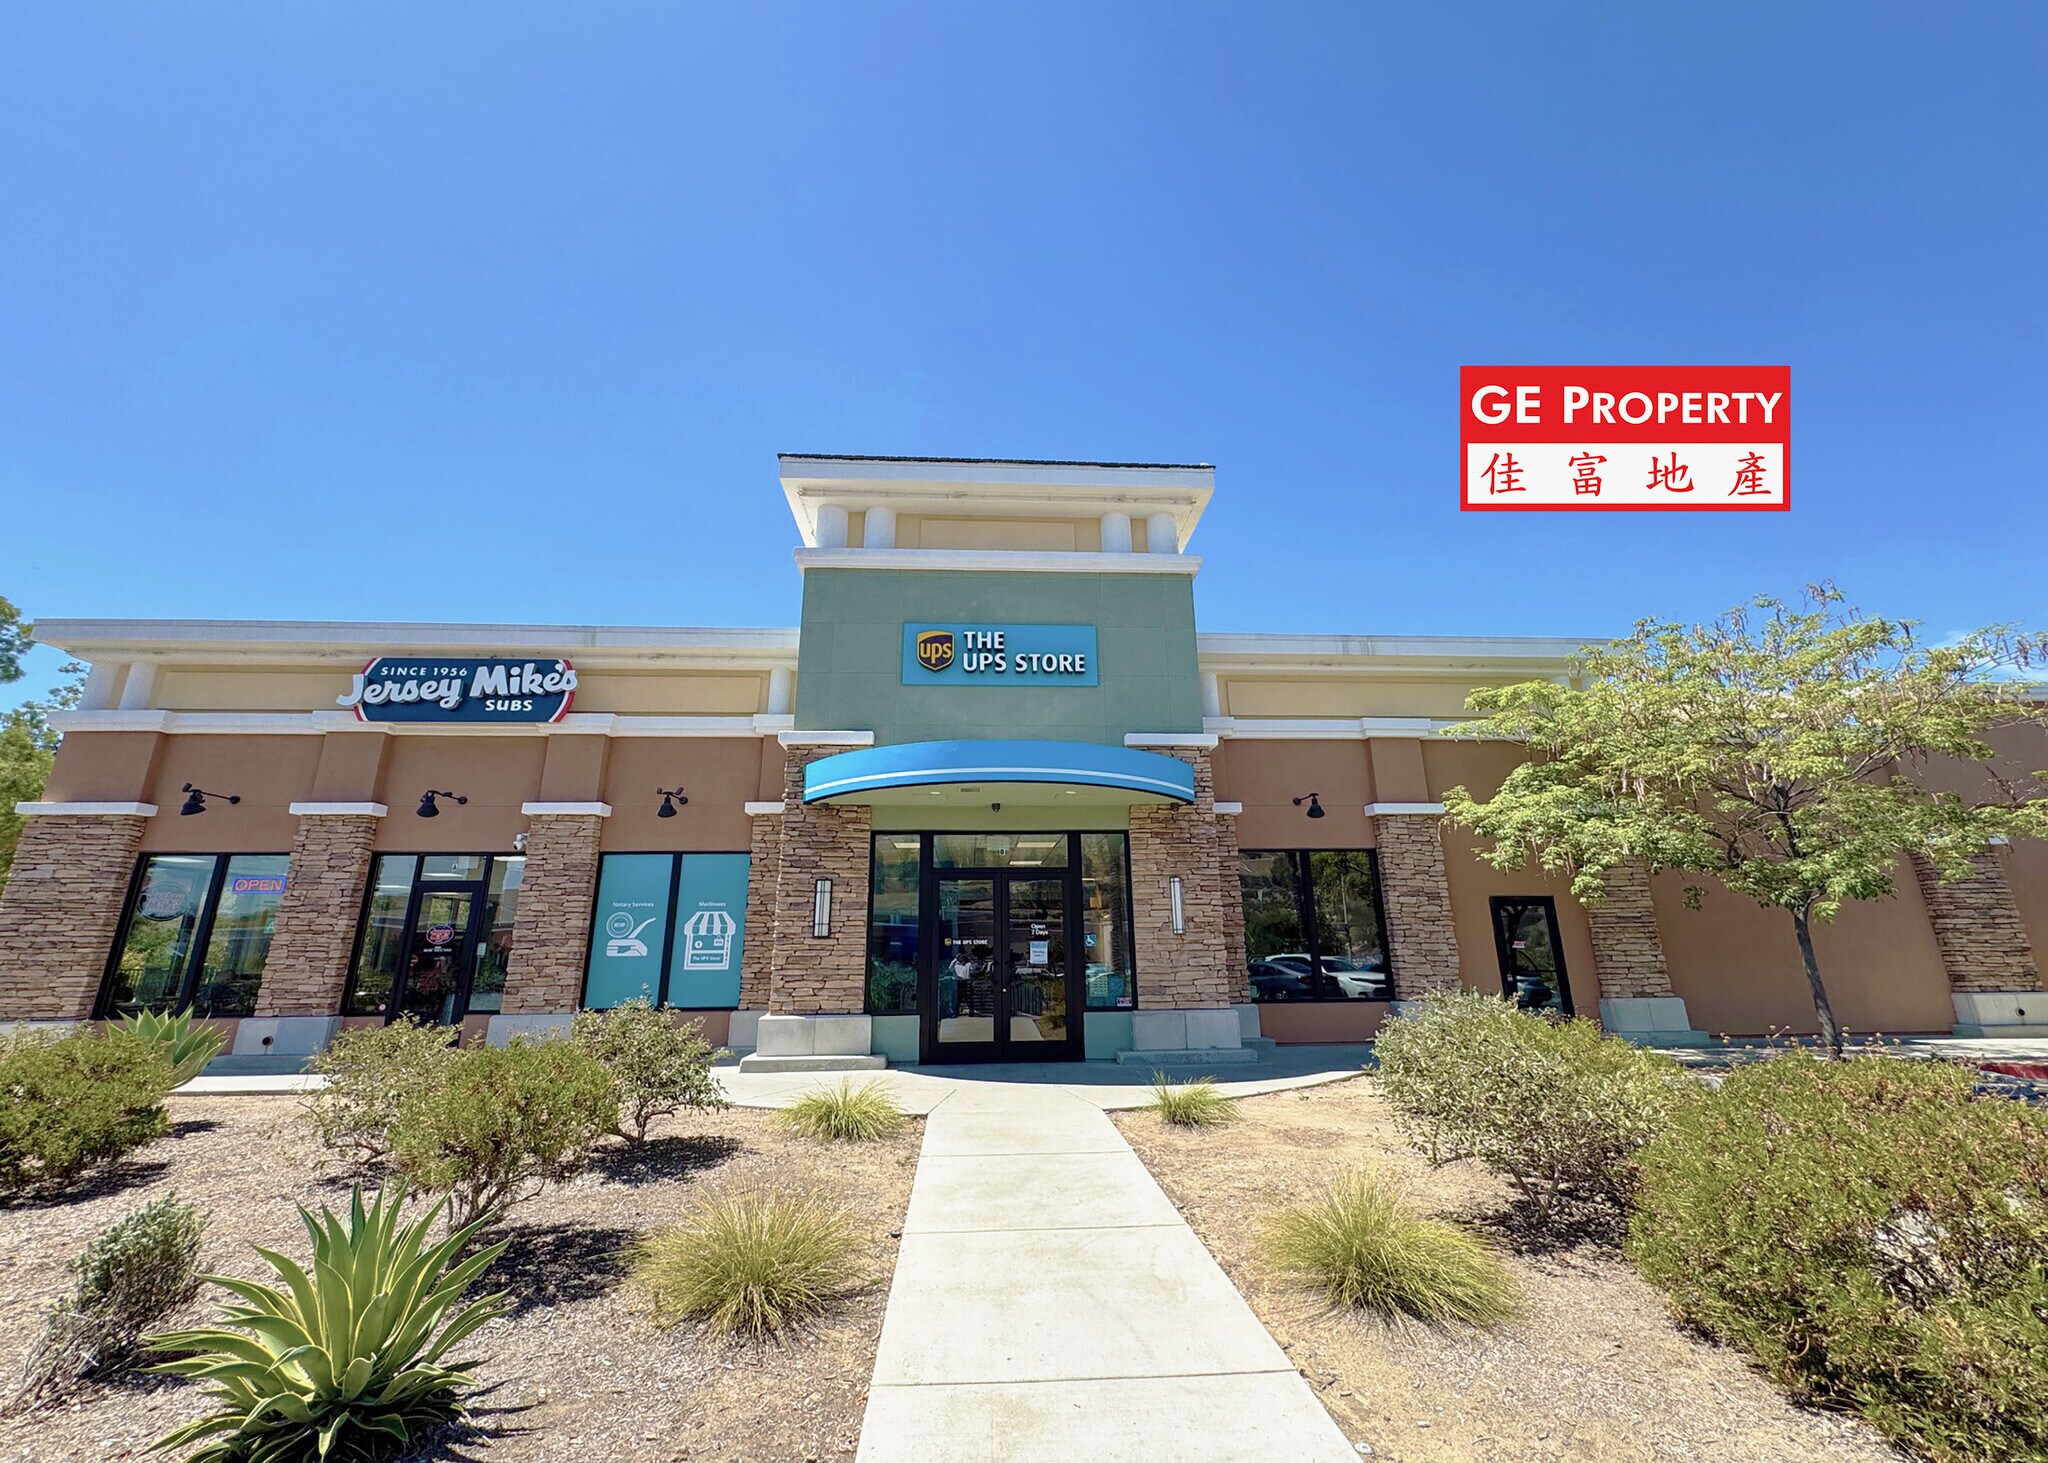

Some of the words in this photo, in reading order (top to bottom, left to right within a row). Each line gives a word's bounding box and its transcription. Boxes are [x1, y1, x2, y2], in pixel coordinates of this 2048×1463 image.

[963, 631, 1005, 649] THE
[919, 642, 952, 664] ups
[963, 653, 1007, 672] UPS
[1015, 653, 1086, 673] STORE
[380, 666, 427, 676] SINCE
[433, 667, 468, 676] 1956
[336, 673, 463, 710] Jersey
[469, 662, 578, 697] Mike's
[485, 699, 533, 712] SUBS
[235, 880, 283, 891] OPEN
[1031, 923, 1046, 931] Open
